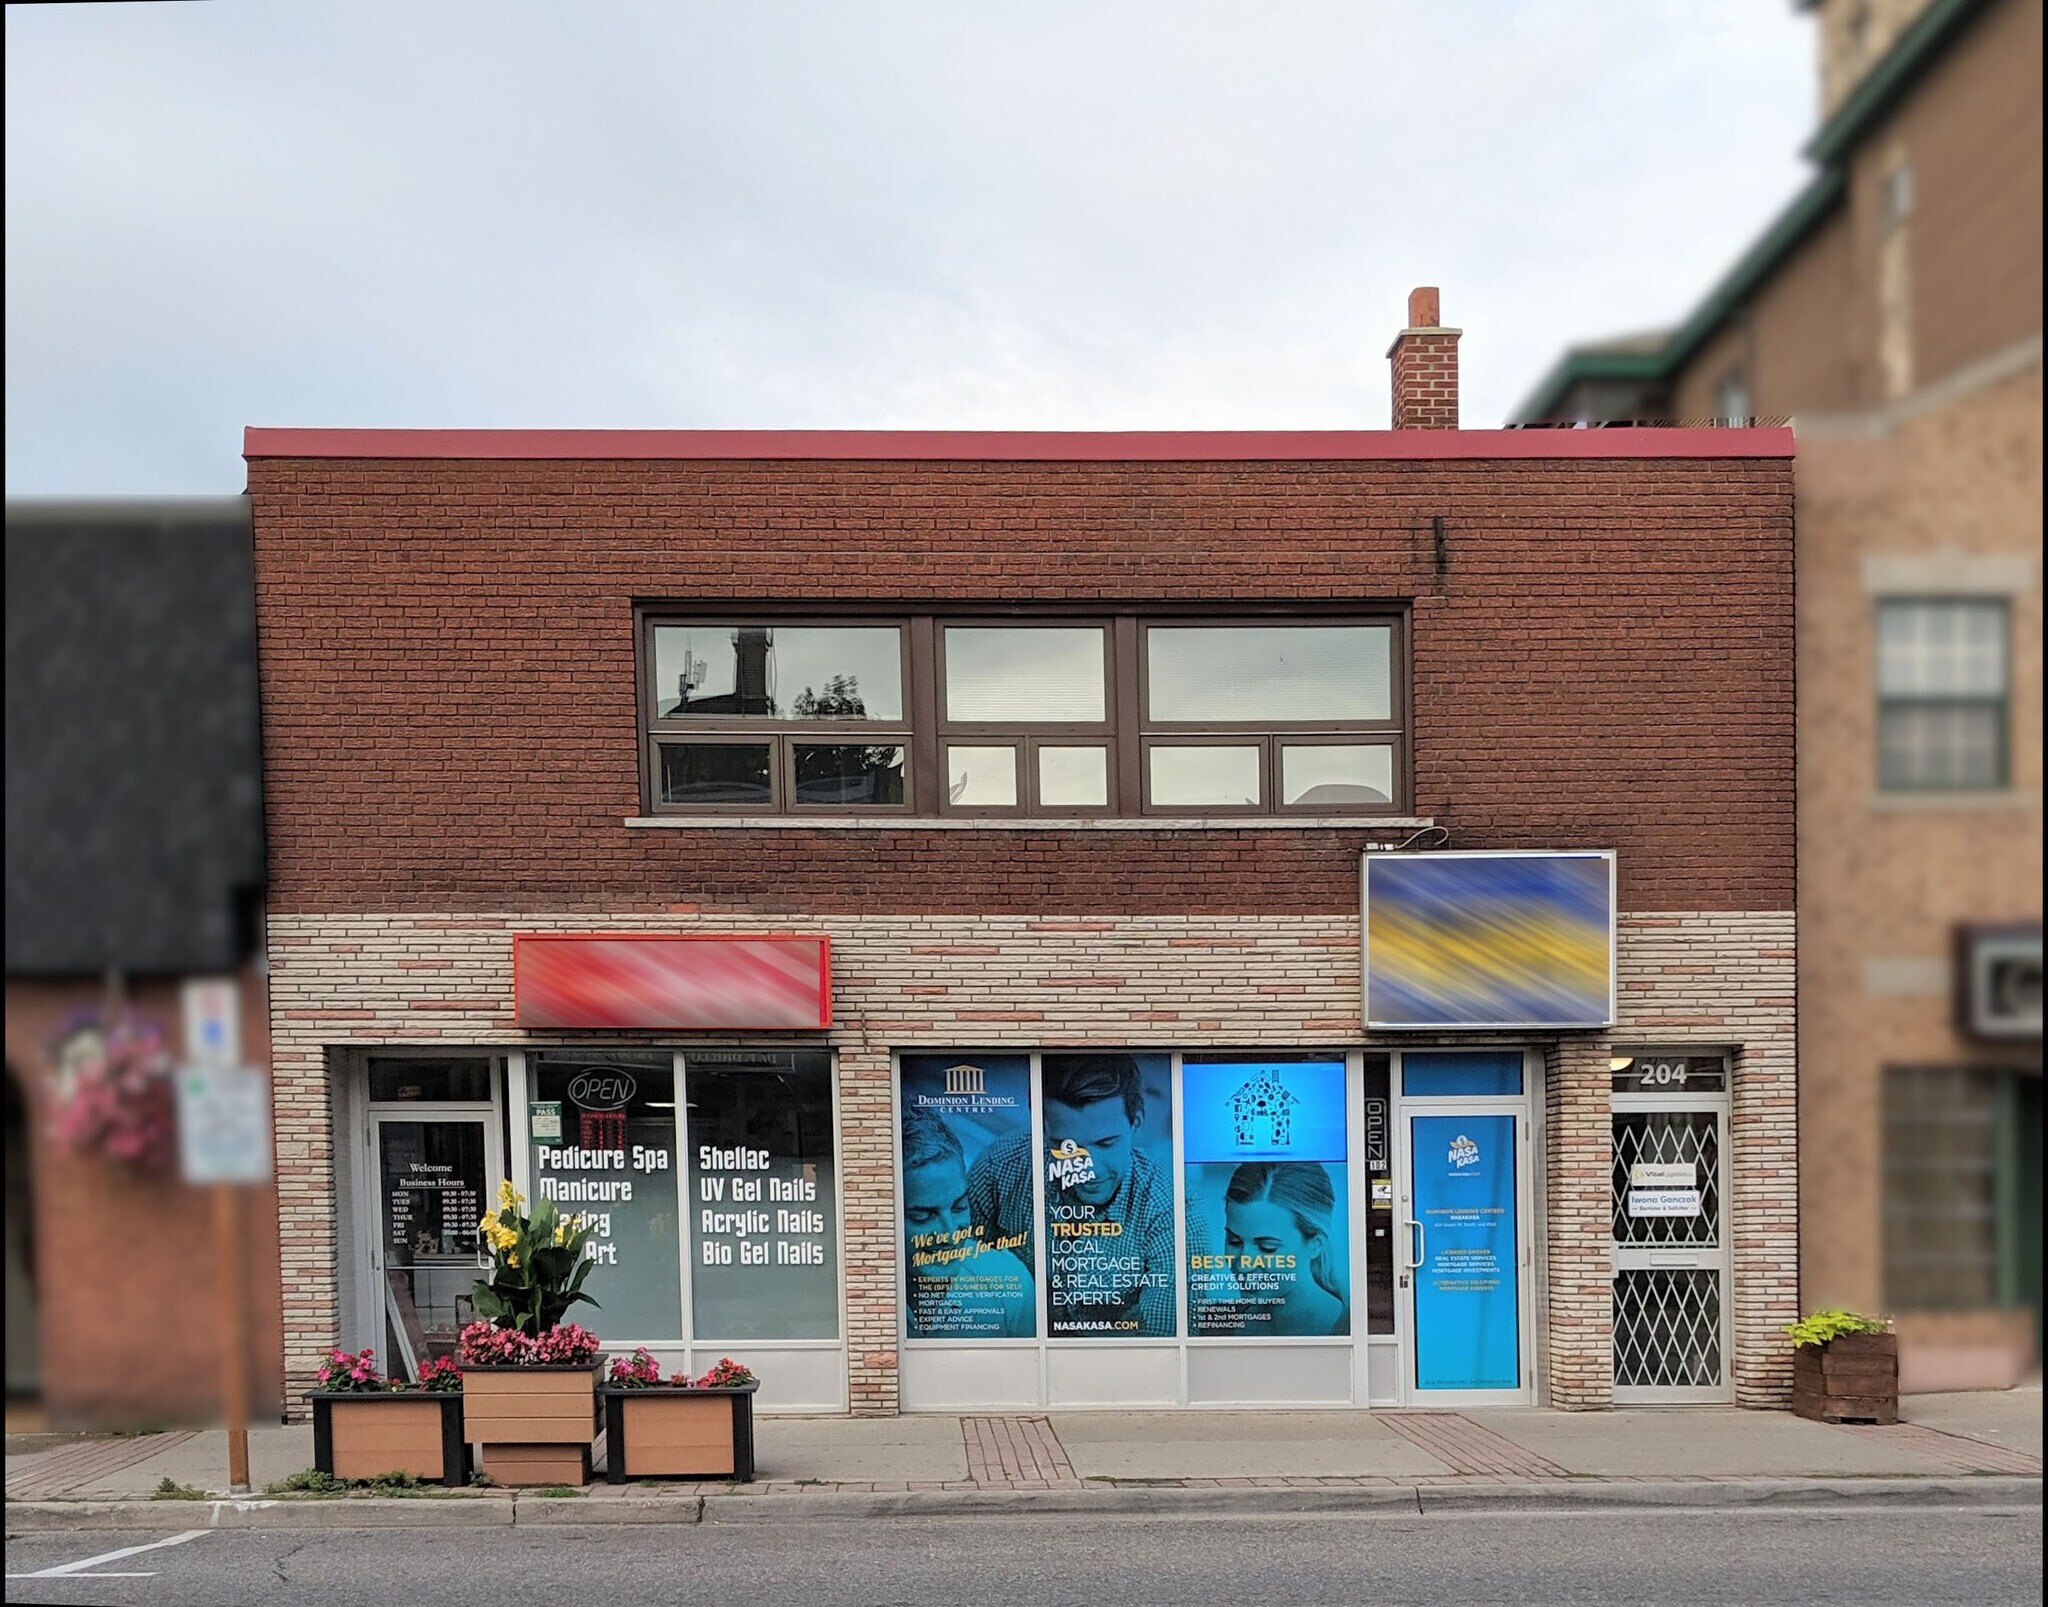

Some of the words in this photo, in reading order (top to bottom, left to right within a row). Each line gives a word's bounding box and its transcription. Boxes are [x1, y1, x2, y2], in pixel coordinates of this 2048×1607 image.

[1640, 1063, 1687, 1085] 204
[572, 1078, 629, 1099] OPEN
[918, 1095, 968, 1104] DOMINION
[972, 1095, 1014, 1104] LENDING
[536, 1108, 555, 1116] PASS
[1367, 1102, 1383, 1159] OPEN
[539, 1145, 624, 1170] Pedicure
[633, 1145, 668, 1174] Spa
[700, 1145, 770, 1170] Shellac
[410, 1163, 453, 1172] Welcome
[1371, 1161, 1386, 1170] 102
[399, 1178, 436, 1187] Business
[438, 1178, 465, 1187] Hours
[540, 1178, 632, 1201] Manicure
[701, 1178, 724, 1201] UV
[732, 1178, 762, 1201] Gel
[769, 1178, 816, 1201] Nails
[1631, 1196, 1658, 1204] Iwona
[1050, 1205, 1095, 1220] YOUR
[702, 1210, 769, 1238] Acrylic
[777, 1210, 824, 1234] Nails
[1051, 1222, 1123, 1237] TRUSTED
[911, 1231, 950, 1248] We've
[952, 1226, 972, 1245] got
[975, 1225, 984, 1236] a
[585, 1240, 617, 1265] Art
[703, 1241, 732, 1265] Bio
[740, 1241, 769, 1265] Gel
[777, 1241, 824, 1265] Nails
[912, 1245, 973, 1268] Mortgage
[972, 1240, 995, 1259] for
[996, 1231, 1028, 1250] that!
[1051, 1240, 1104, 1254] LOCAL
[1051, 1257, 1140, 1271] MORTGAGE
[1191, 1255, 1235, 1269] BEST
[1240, 1255, 1296, 1268] RATES
[1051, 1274, 1063, 1288] &
[1067, 1274, 1108, 1288] REAL
[1112, 1274, 1169, 1288] ESTATE
[1191, 1273, 1236, 1282] CREATIVE
[1238, 1273, 1245, 1281] &
[1246, 1273, 1296, 1281] EFFECTIVE
[1191, 1282, 1224, 1290] CREDIT
[1227, 1282, 1279, 1290] SOLUTIONS
[1052, 1291, 1125, 1305] EXPERTS.
[1053, 1321, 1139, 1331] NASAKASA.COM
